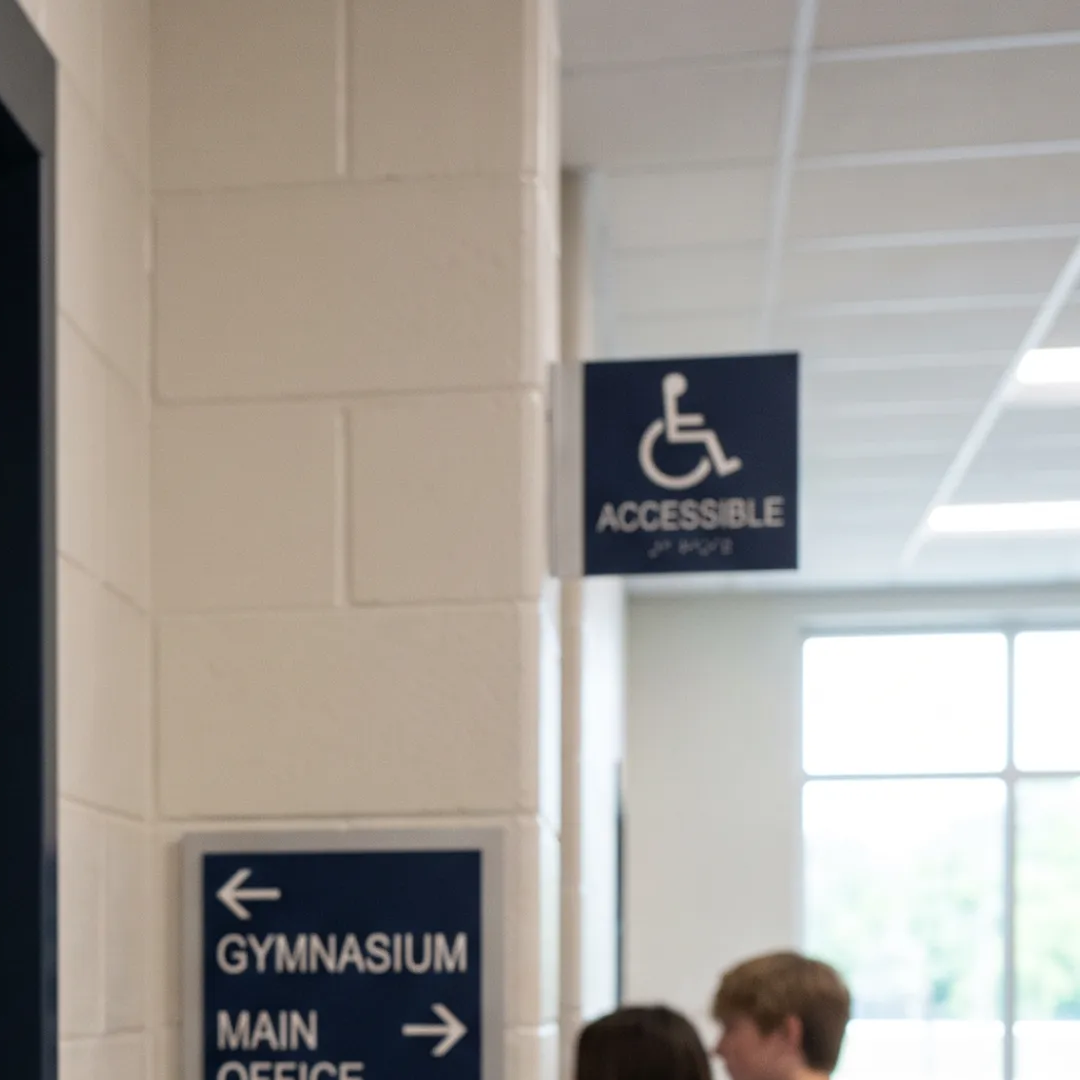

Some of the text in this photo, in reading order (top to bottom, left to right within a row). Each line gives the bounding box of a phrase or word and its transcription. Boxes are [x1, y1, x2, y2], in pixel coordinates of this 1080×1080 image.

[595, 496, 785, 533] ACCESSIBLE
[216, 931, 468, 975] GYMNASIUM
[216, 1009, 318, 1051] MAIN
